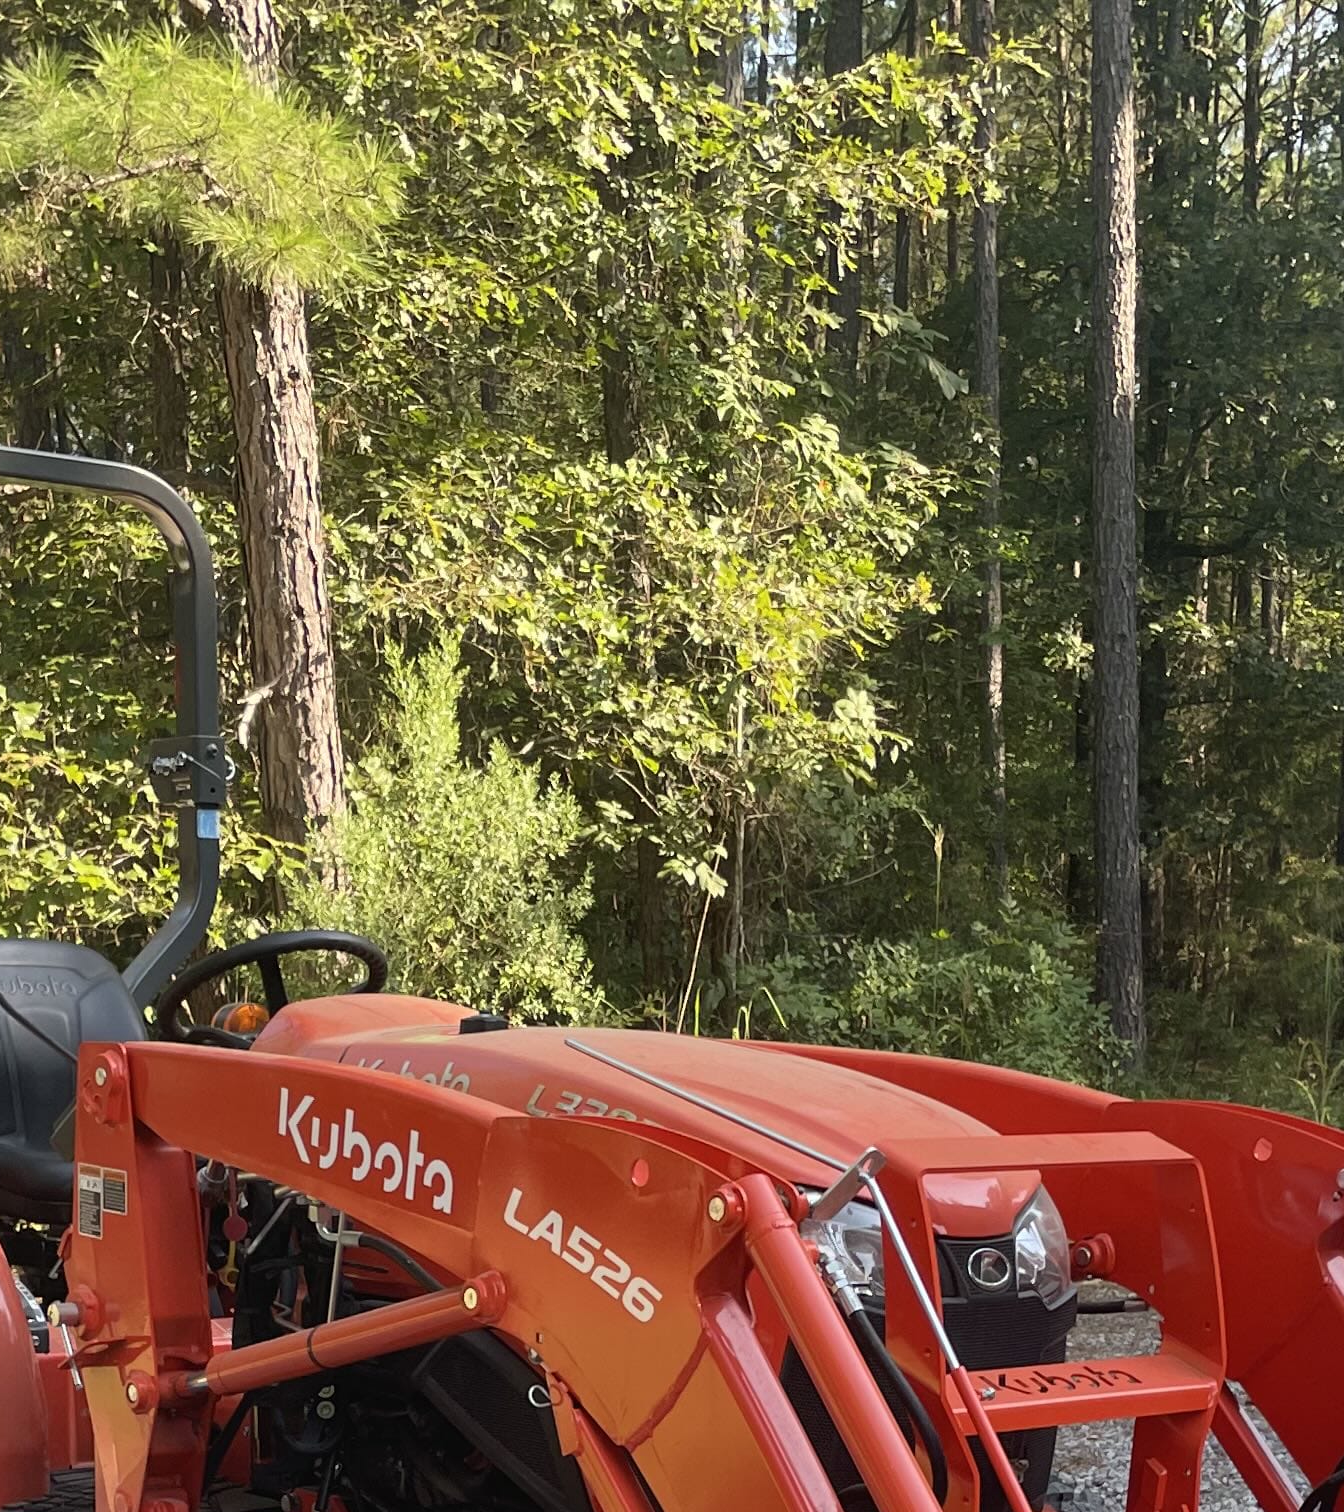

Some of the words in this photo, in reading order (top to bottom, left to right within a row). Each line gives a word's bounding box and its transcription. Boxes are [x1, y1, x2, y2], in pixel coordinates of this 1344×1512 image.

[278, 1087, 453, 1214] Kubota
[503, 1187, 663, 1323] LA526
[978, 1366, 1142, 1395] Kubota
